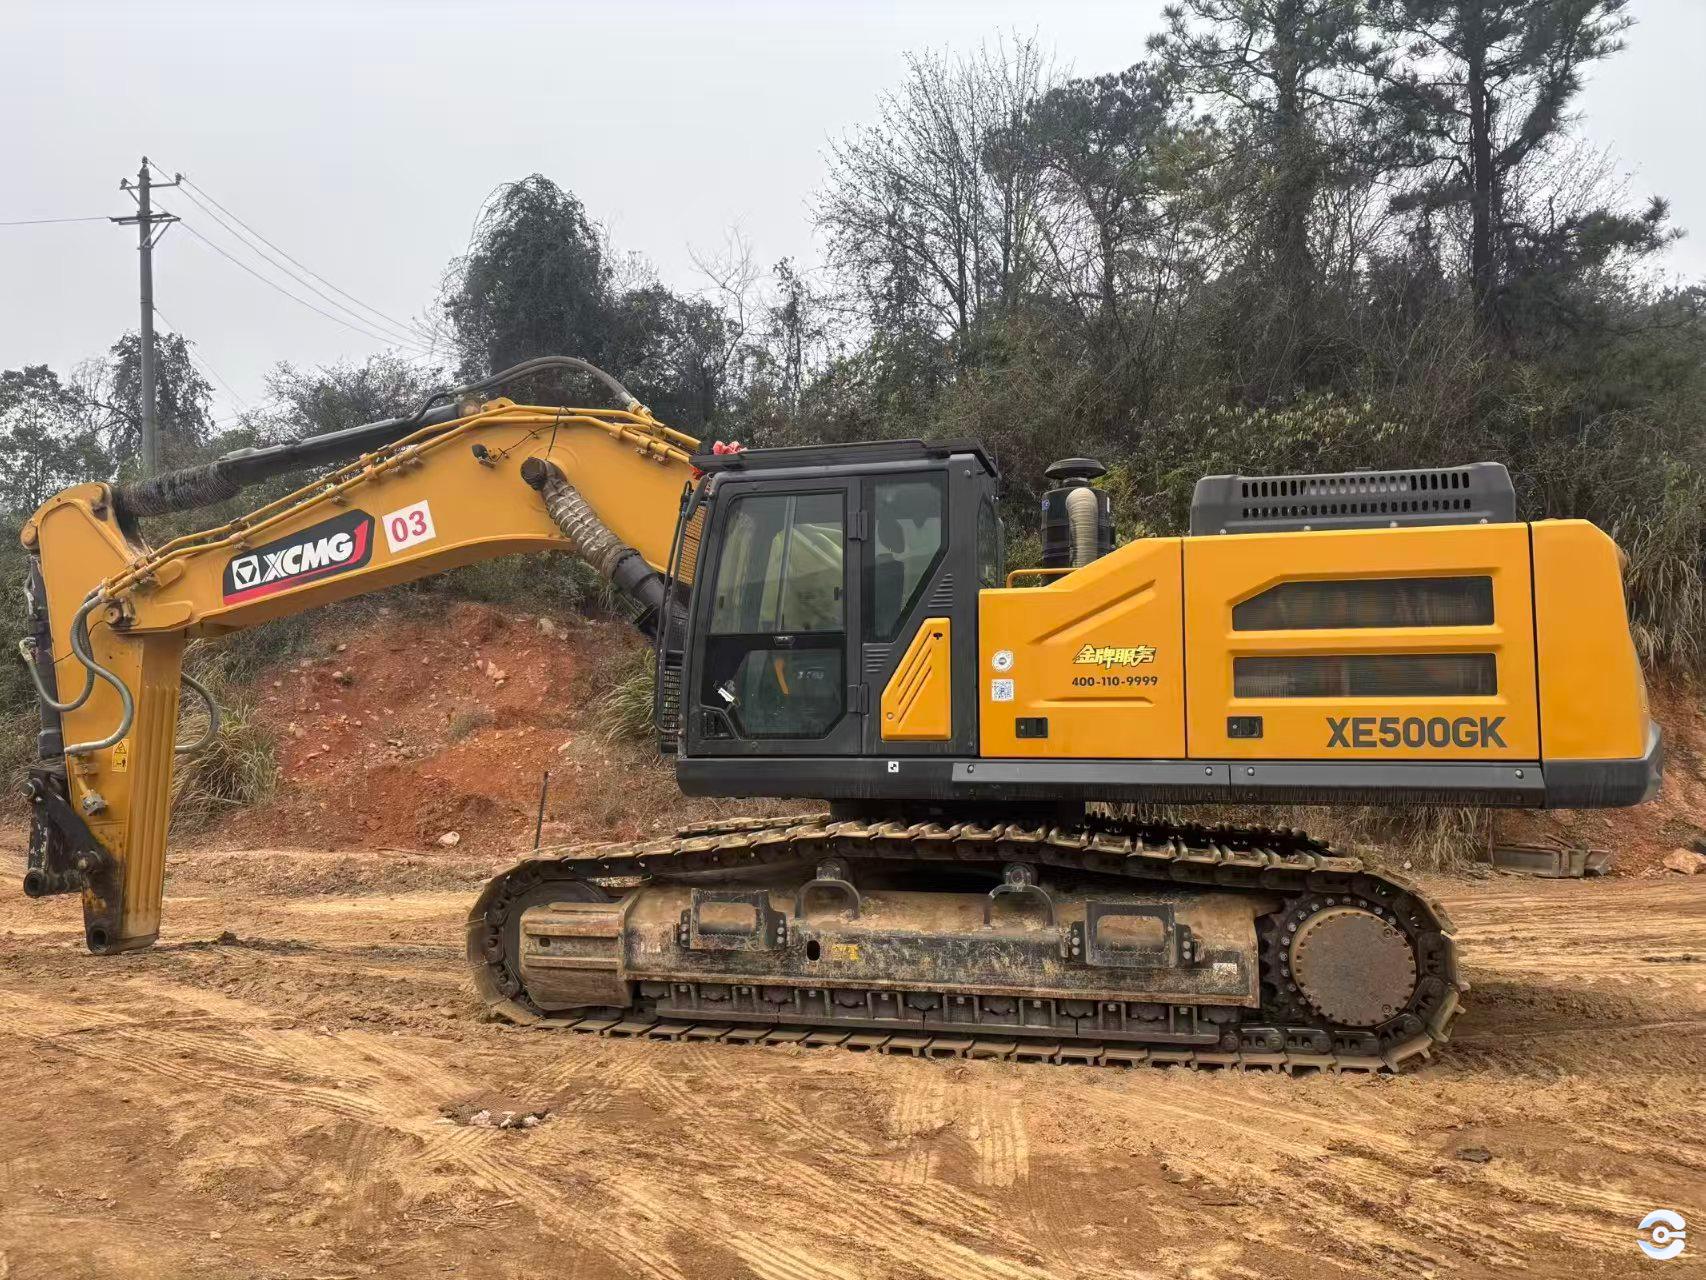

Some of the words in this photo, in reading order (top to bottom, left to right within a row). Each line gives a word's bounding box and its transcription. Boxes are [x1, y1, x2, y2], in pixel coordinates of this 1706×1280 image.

[390, 510, 427, 543] 03
[262, 532, 353, 582] XCMG
[1073, 644, 1157, 669] 金牌服务
[1072, 676, 1158, 687] 400-110-9999
[1325, 716, 1508, 748] XE500GK
